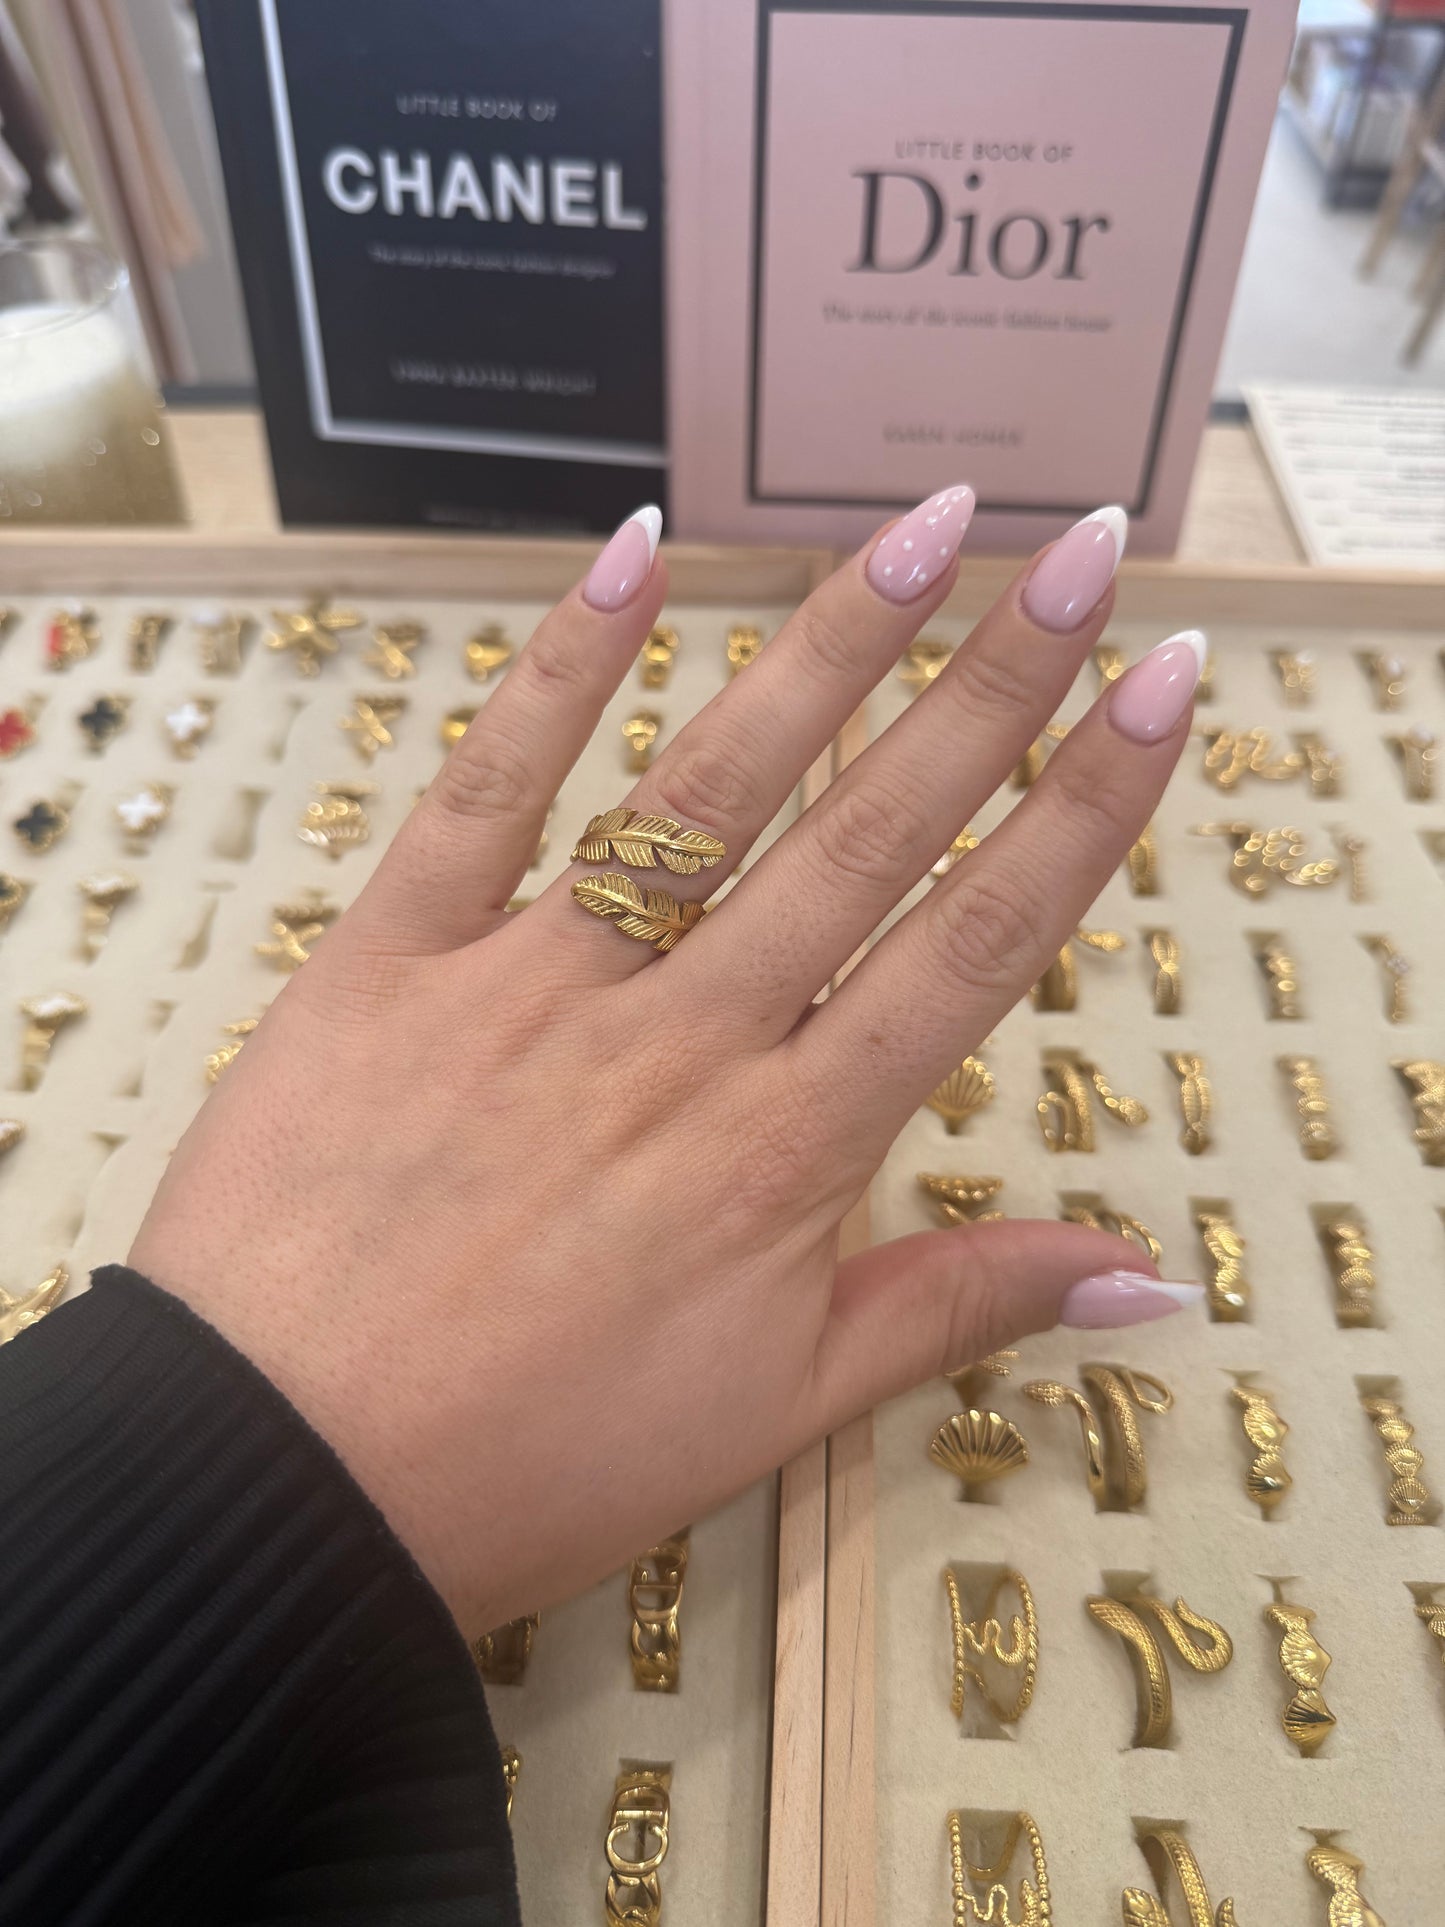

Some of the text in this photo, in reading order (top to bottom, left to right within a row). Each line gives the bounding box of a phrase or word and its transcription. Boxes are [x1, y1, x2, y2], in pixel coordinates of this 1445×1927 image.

[396, 94, 557, 123] LITTLE BOOK OF
[895, 141, 1074, 164] LITTLE BOOK OF
[323, 147, 648, 231] CHANEL
[845, 169, 1112, 281] Dior
